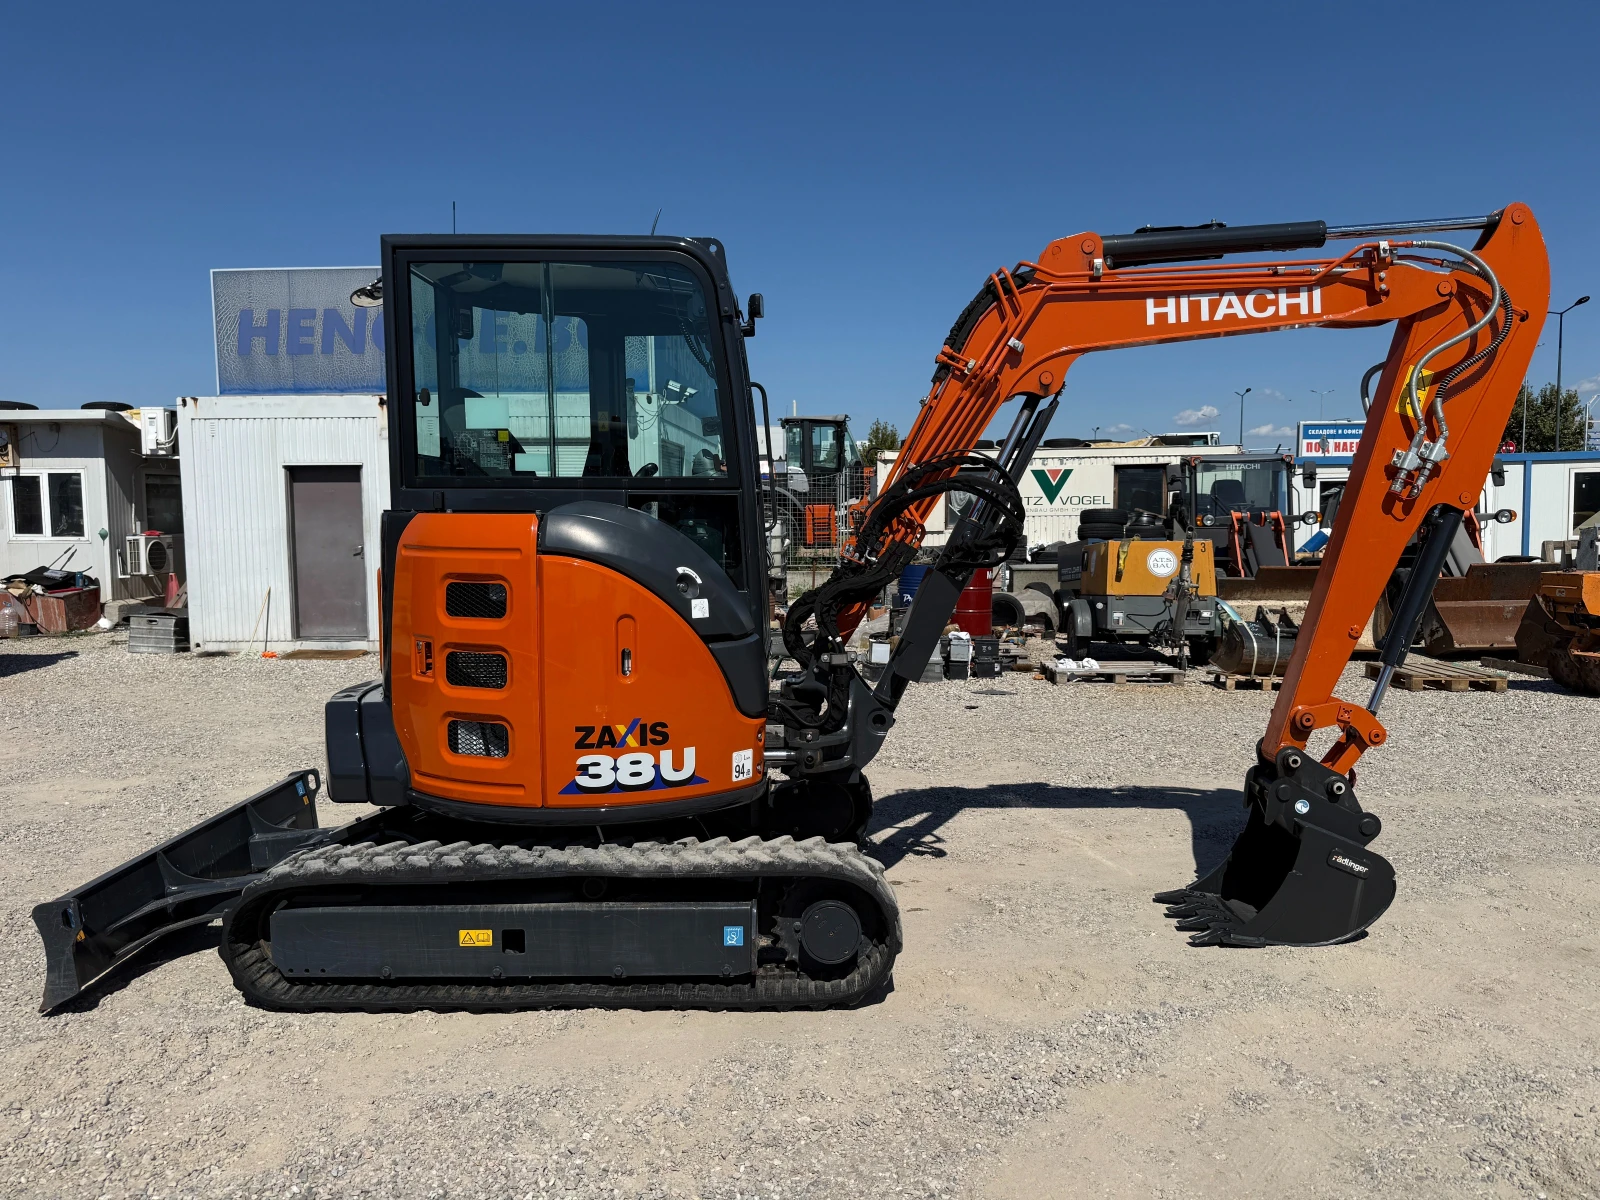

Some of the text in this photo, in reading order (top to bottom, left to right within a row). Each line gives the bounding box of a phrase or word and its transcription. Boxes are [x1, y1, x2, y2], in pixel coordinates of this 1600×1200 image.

[1146, 286, 1322, 325] HITACHI
[1060, 496, 1111, 506] VOGEL
[1200, 542, 1206, 553] 3
[574, 718, 670, 750] ZAXIS
[575, 747, 696, 792] 38U
[735, 763, 745, 779] 94
